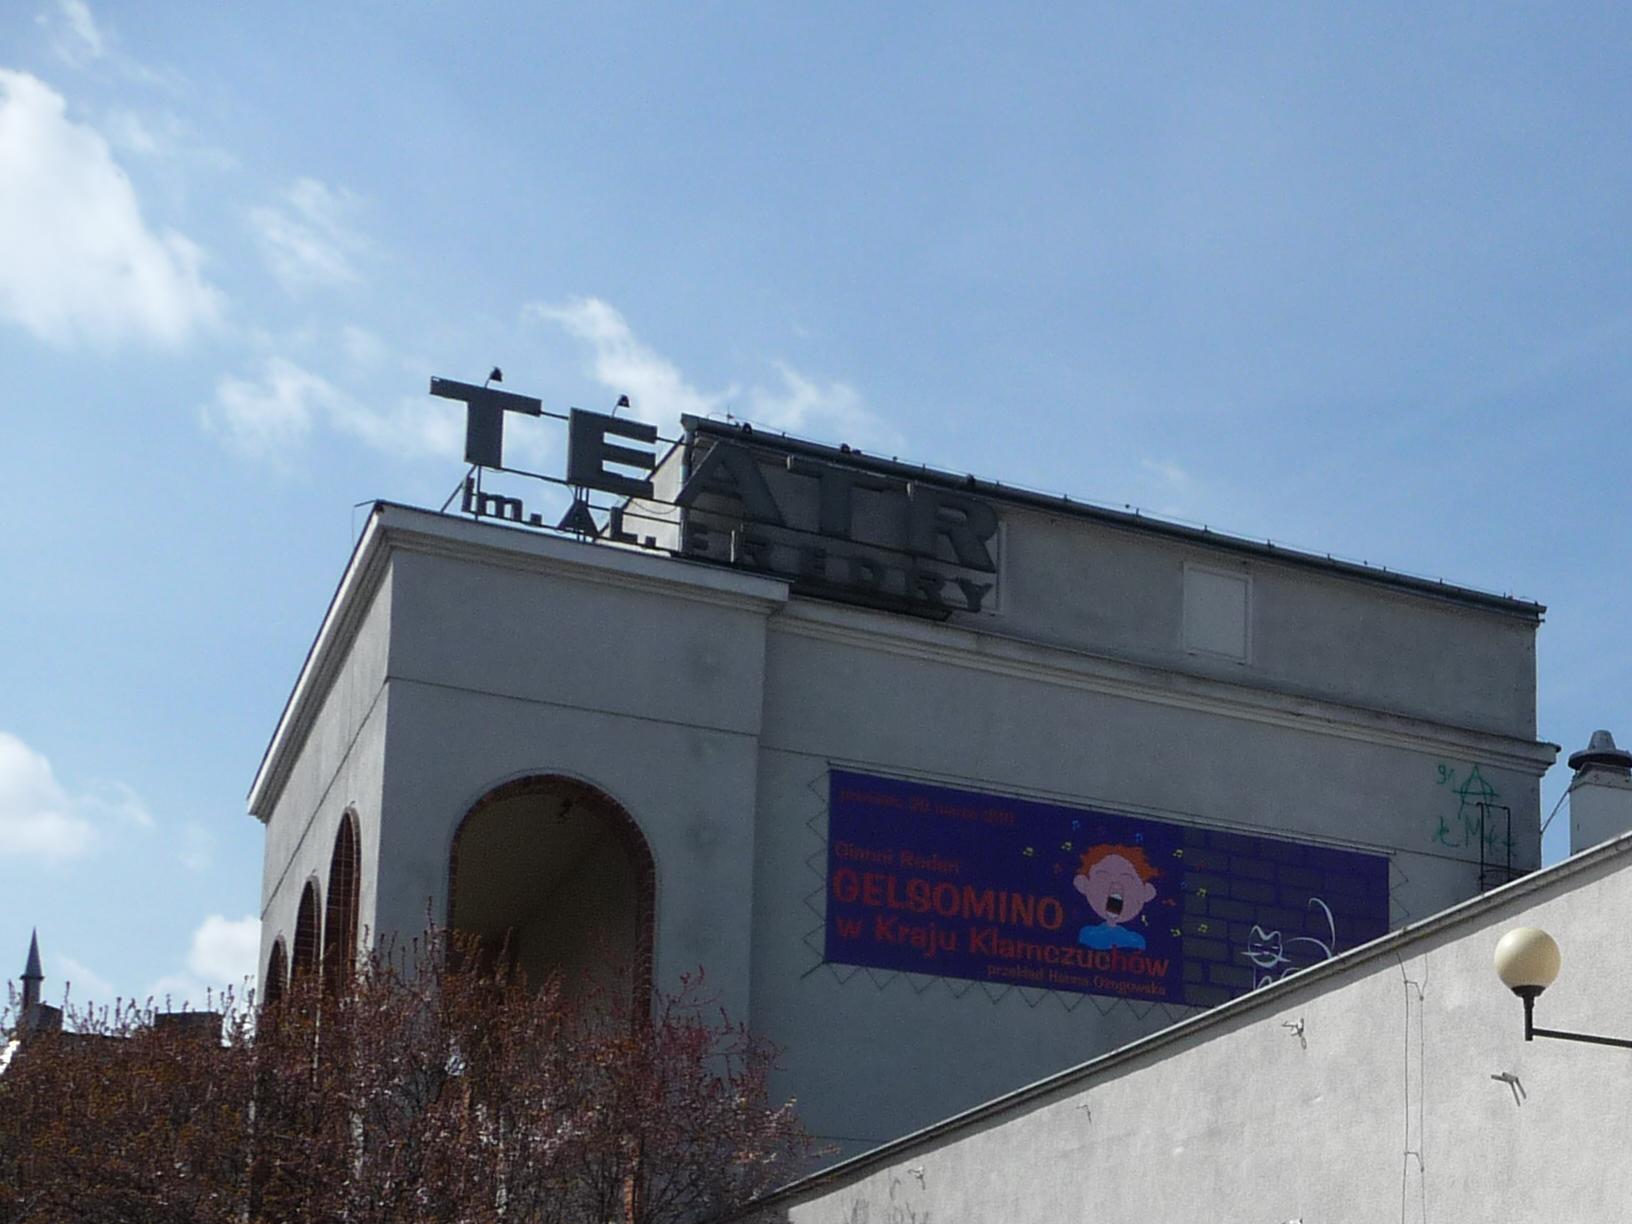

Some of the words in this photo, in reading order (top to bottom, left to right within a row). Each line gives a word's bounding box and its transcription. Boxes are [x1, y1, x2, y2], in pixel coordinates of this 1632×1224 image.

[430, 376, 997, 573] TEATR
[833, 867, 1065, 931] GELSOMINO
[837, 918, 861, 938] w
[875, 914, 957, 957] Kraju
